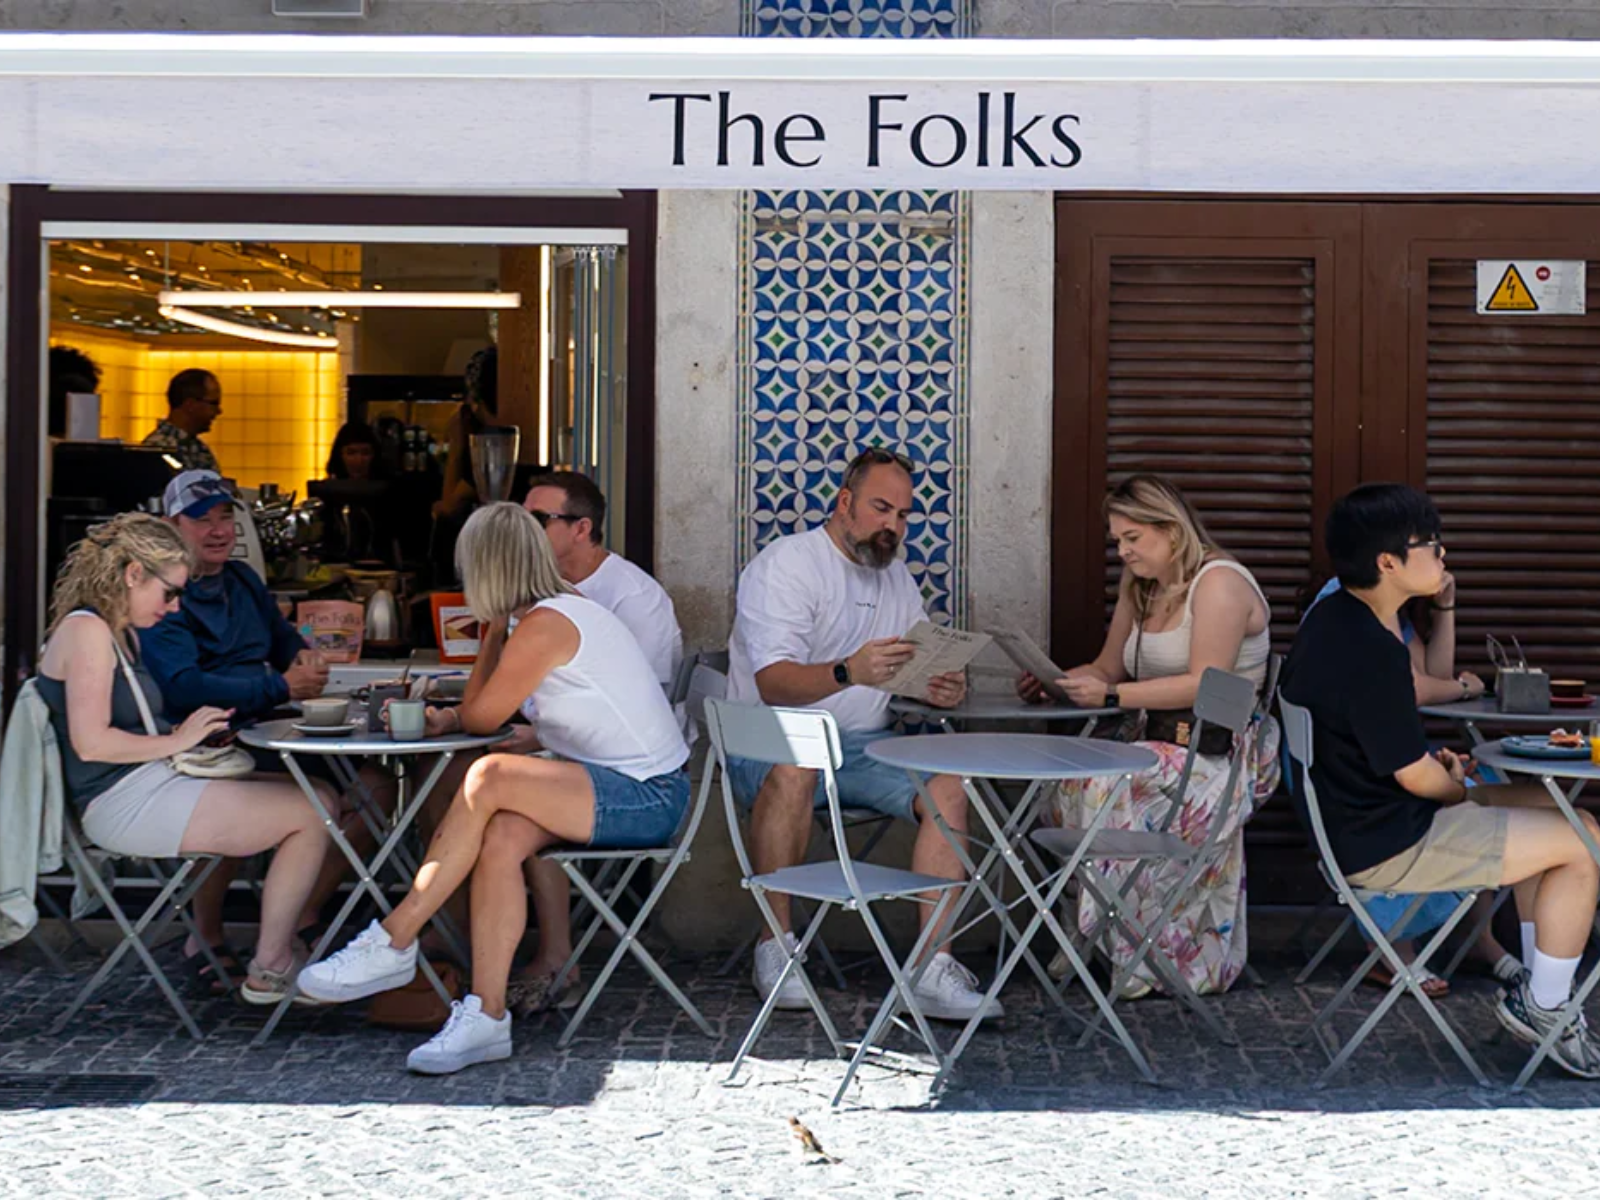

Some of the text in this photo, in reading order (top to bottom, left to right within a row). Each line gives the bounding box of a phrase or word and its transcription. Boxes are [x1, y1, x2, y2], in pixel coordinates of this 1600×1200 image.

[648, 91, 1082, 167] The Folks
[305, 613, 329, 624] The
[932, 627, 948, 638] The
